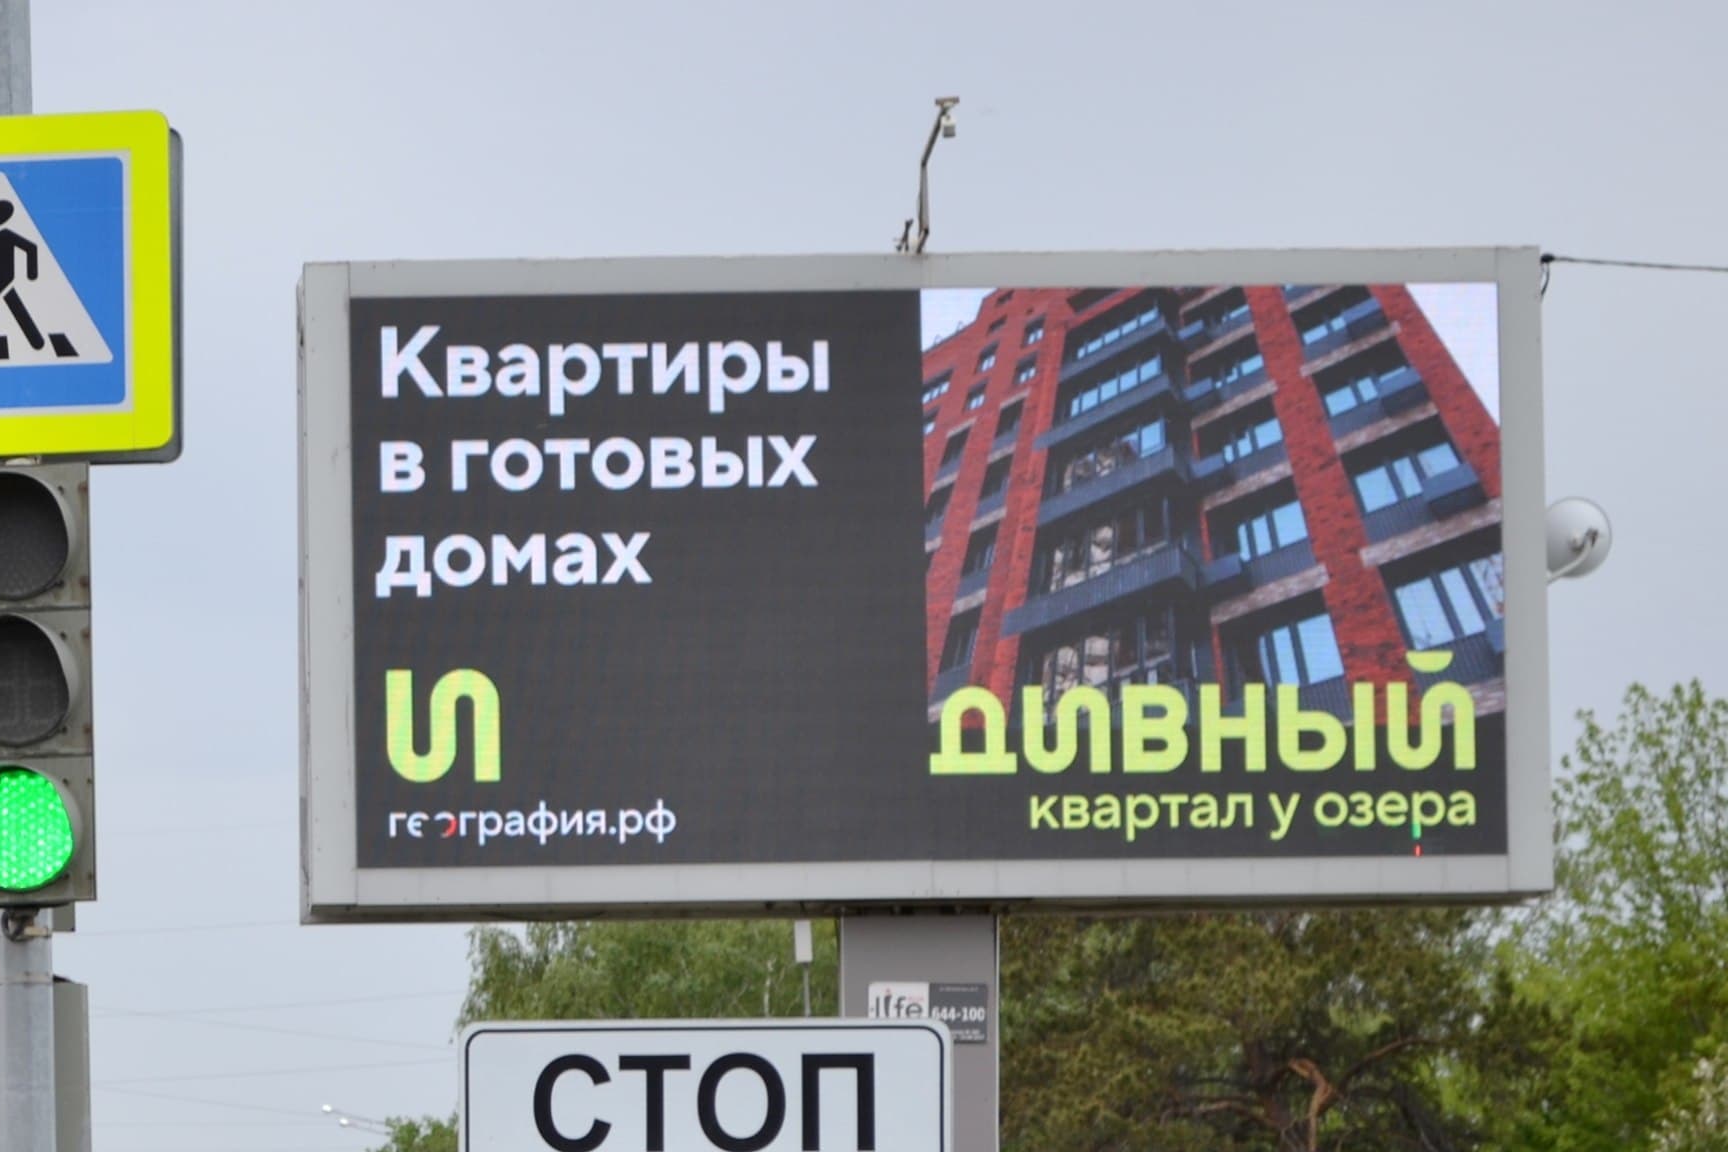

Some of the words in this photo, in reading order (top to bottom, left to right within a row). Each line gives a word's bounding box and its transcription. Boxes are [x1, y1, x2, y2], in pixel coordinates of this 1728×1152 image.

[379, 324, 831, 417] Квартиры
[379, 440, 427, 494] в
[450, 434, 819, 493] готовых
[375, 530, 653, 599] домах
[1029, 791, 1254, 843] квартал
[1268, 791, 1301, 841] у
[1313, 789, 1477, 840] озера
